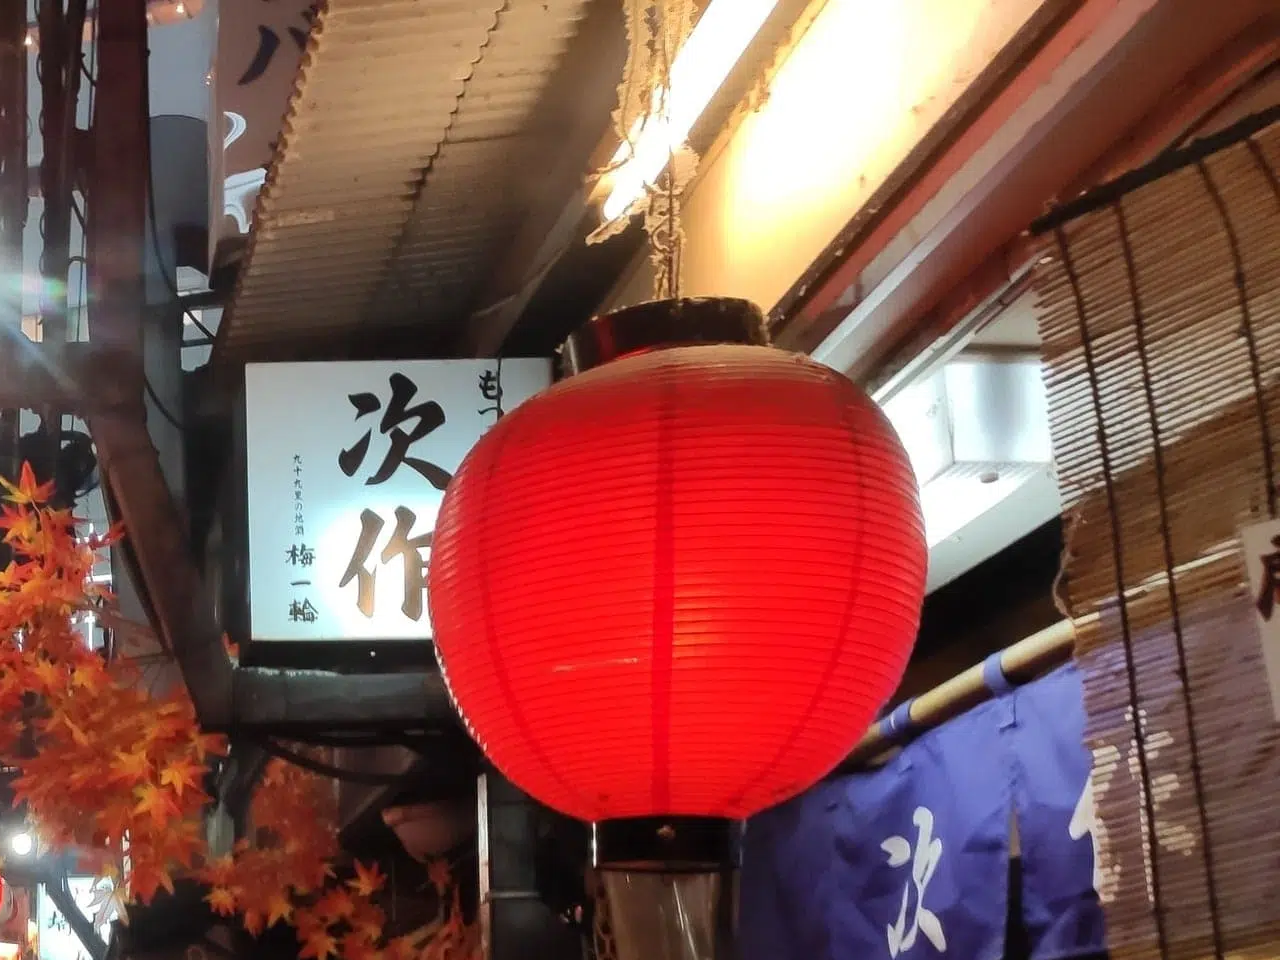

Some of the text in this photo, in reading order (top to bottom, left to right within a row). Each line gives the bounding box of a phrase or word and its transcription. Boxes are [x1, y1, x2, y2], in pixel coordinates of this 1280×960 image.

[339, 372, 454, 622] 次作
[285, 542, 319, 625] 梅一輪
